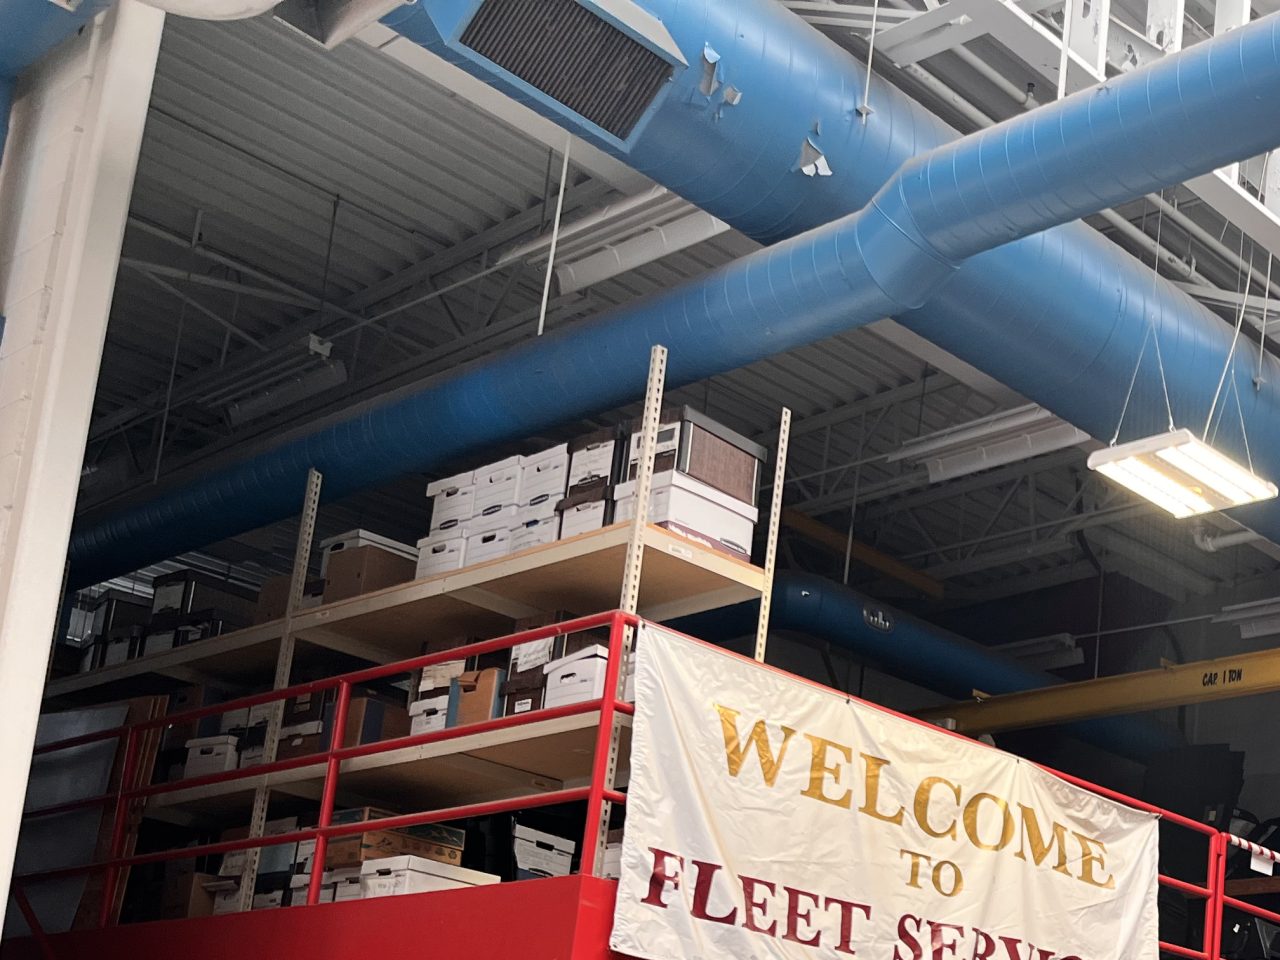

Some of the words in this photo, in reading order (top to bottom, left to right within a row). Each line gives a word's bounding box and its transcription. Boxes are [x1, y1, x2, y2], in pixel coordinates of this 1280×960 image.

[1228, 668, 1243, 683] TON
[712, 703, 1116, 890] WELCOME
[640, 847, 872, 955] FLEET
[900, 849, 964, 897] TO
